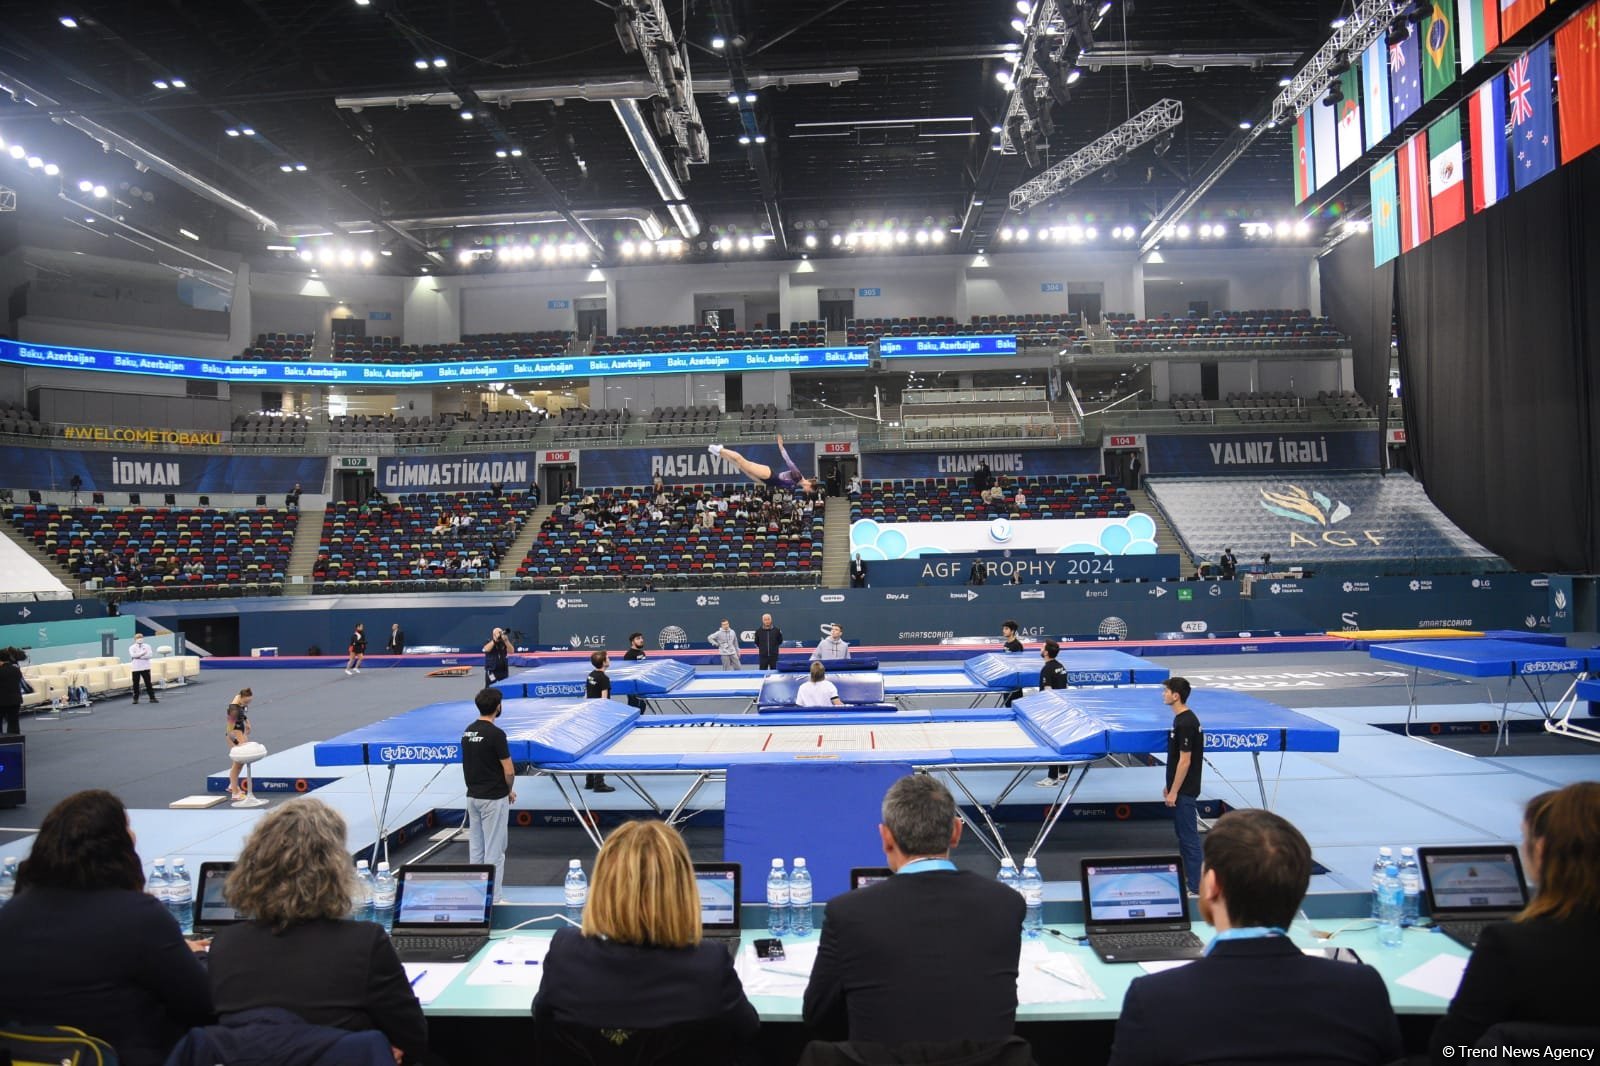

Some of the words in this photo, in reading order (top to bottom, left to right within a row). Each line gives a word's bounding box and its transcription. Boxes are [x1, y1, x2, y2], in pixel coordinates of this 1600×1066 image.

[863, 288, 877, 297] 305
[917, 341, 938, 352] Baku,
[940, 341, 980, 352] Azerbaijan
[20, 347, 45, 361] Baku,
[47, 351, 96, 364] Azerbaijan
[746, 354, 767, 364] Baku,
[768, 353, 808, 364] Azerbaijan
[825, 352, 847, 363] Baku,
[114, 355, 138, 368] Baku,
[139, 359, 185, 371] Azerbaijan
[590, 360, 610, 370] Baku,
[611, 359, 651, 371] Azerbaijan
[667, 358, 687, 368] Baku,
[690, 356, 729, 368] Azerbaijan
[202, 363, 224, 375] Baku,
[225, 366, 268, 376] Azerbaijan
[284, 366, 305, 376] Baku,
[306, 367, 347, 378] Azerbaijan
[363, 368, 384, 378] Baku,
[385, 369, 423, 380] Azerbaijan
[439, 367, 458, 377] Baku,
[460, 366, 498, 377] Azerbaijan
[513, 364, 533, 374] Baku,
[534, 363, 574, 374] Azerbaijan
[64, 426, 222, 445] #WELCOMETOBAKU
[1115, 437, 1130, 446] 104
[831, 444, 845, 452] 105
[1209, 442, 1274, 465] YALNIZ
[938, 454, 1024, 473] CHAMPIONS
[113, 457, 181, 486] İDMAN
[385, 459, 527, 487] GİMNASTİKADAN
[1290, 530, 1385, 548] AGF
[922, 562, 961, 578] AGF
[972, 560, 1056, 577] ROPHY
[1067, 559, 1114, 575] 2024
[1022, 627, 1045, 636] AGF
[1186, 623, 1203, 631] AZE
[584, 635, 606, 644] AGF
[899, 631, 954, 640] SMARTSCORING
[1203, 733, 1269, 748] ROTRAMP
[381, 745, 458, 761] EUROTRAMP
